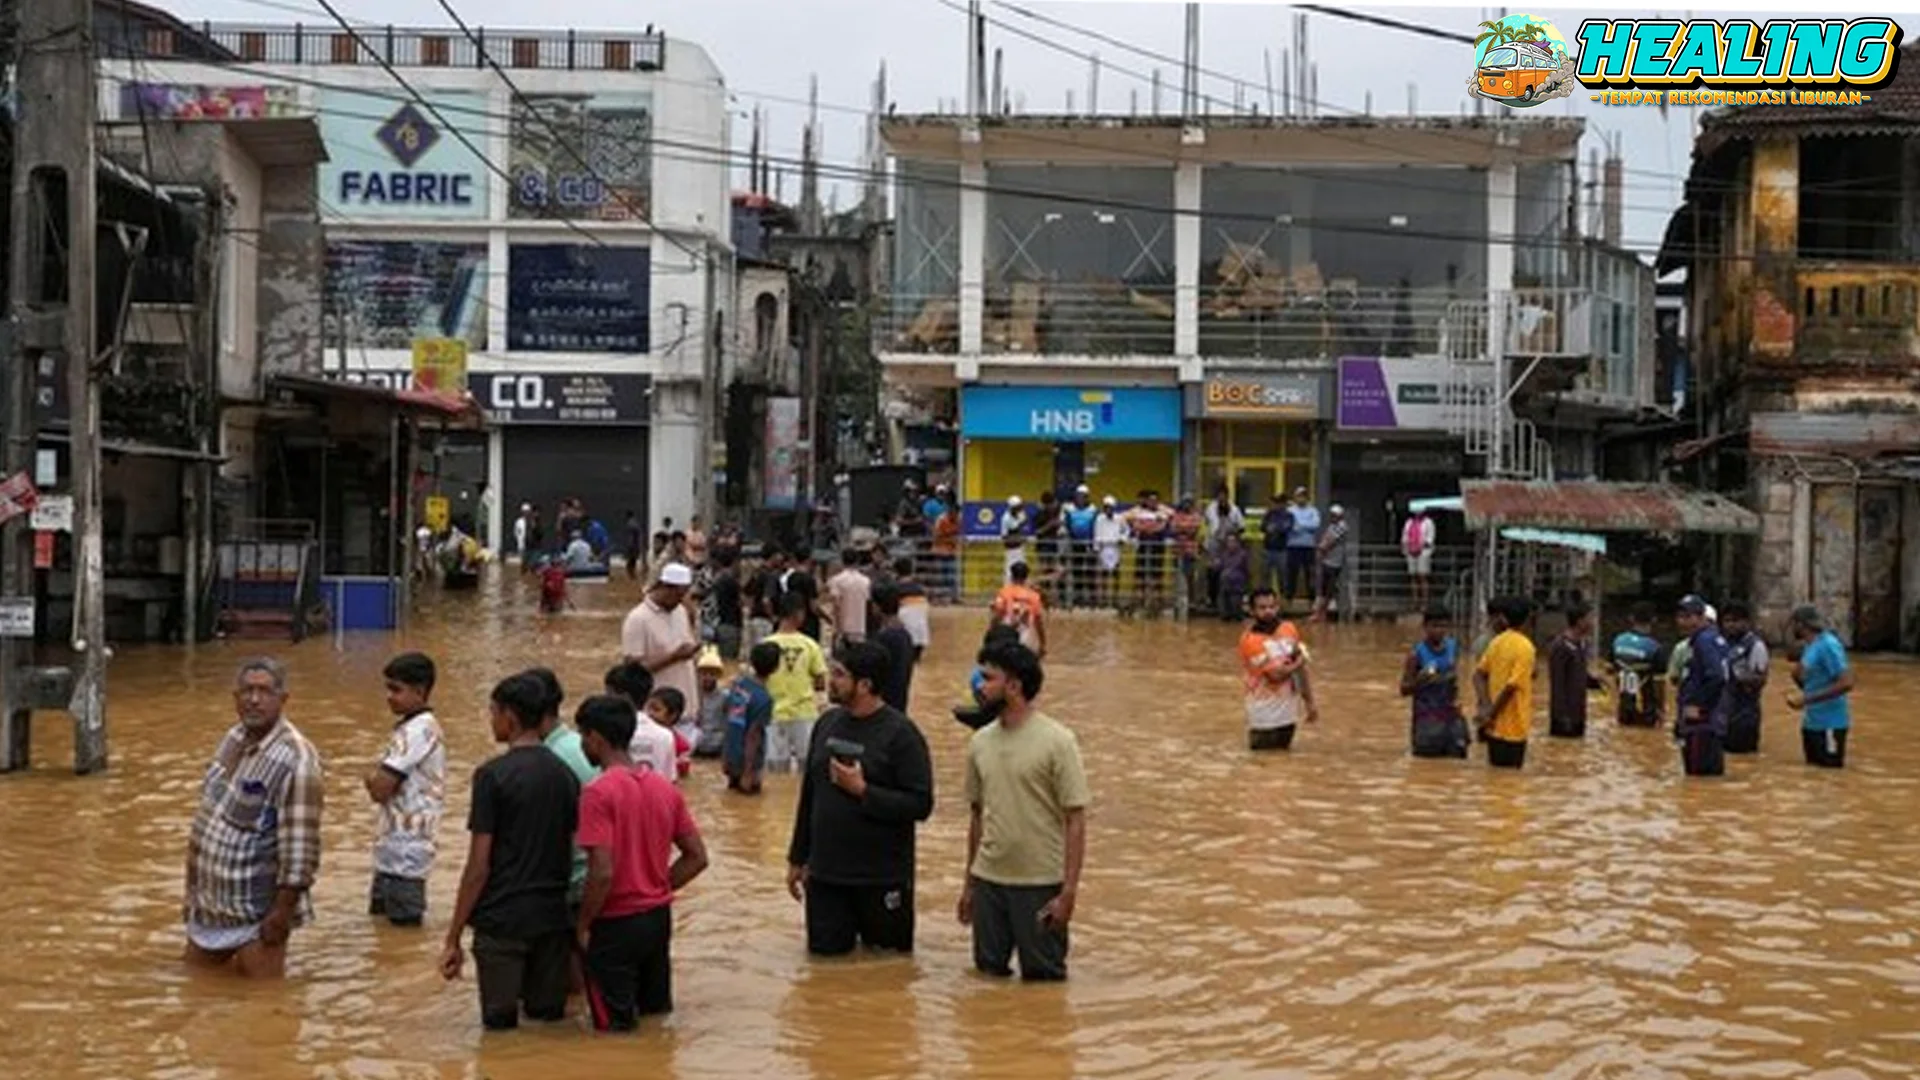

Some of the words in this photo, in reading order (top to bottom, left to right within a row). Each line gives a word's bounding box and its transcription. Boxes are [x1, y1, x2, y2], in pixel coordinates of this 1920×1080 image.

[340, 171, 472, 205] FABRIC
[519, 170, 549, 206] &
[491, 375, 554, 409] CO.
[1207, 381, 1263, 406] BOC
[1031, 409, 1096, 435] HNB
[1618, 669, 1640, 695] 10
